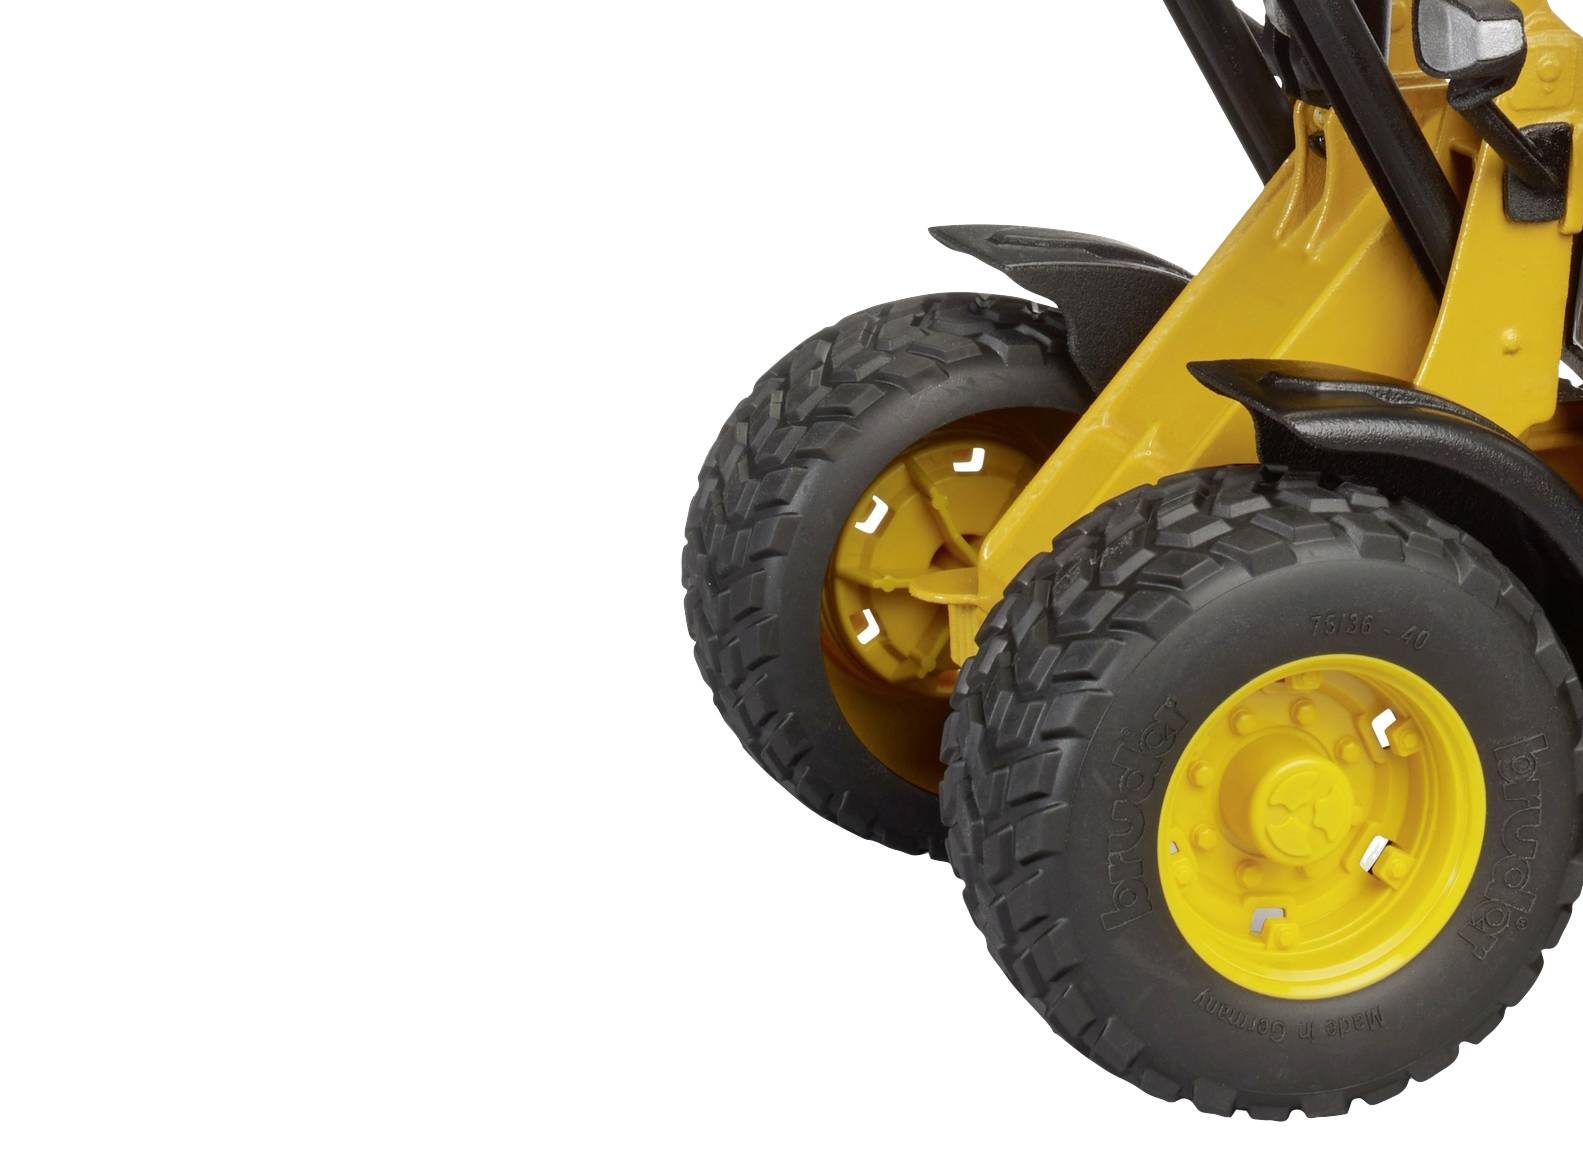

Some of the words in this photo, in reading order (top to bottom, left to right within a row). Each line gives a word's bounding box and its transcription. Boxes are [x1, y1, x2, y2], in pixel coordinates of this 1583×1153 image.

[1400, 625, 1432, 649] 40
[1192, 986, 1288, 1044] Germany
[1324, 1003, 1384, 1040] Made
[1297, 1020, 1314, 1042] in
